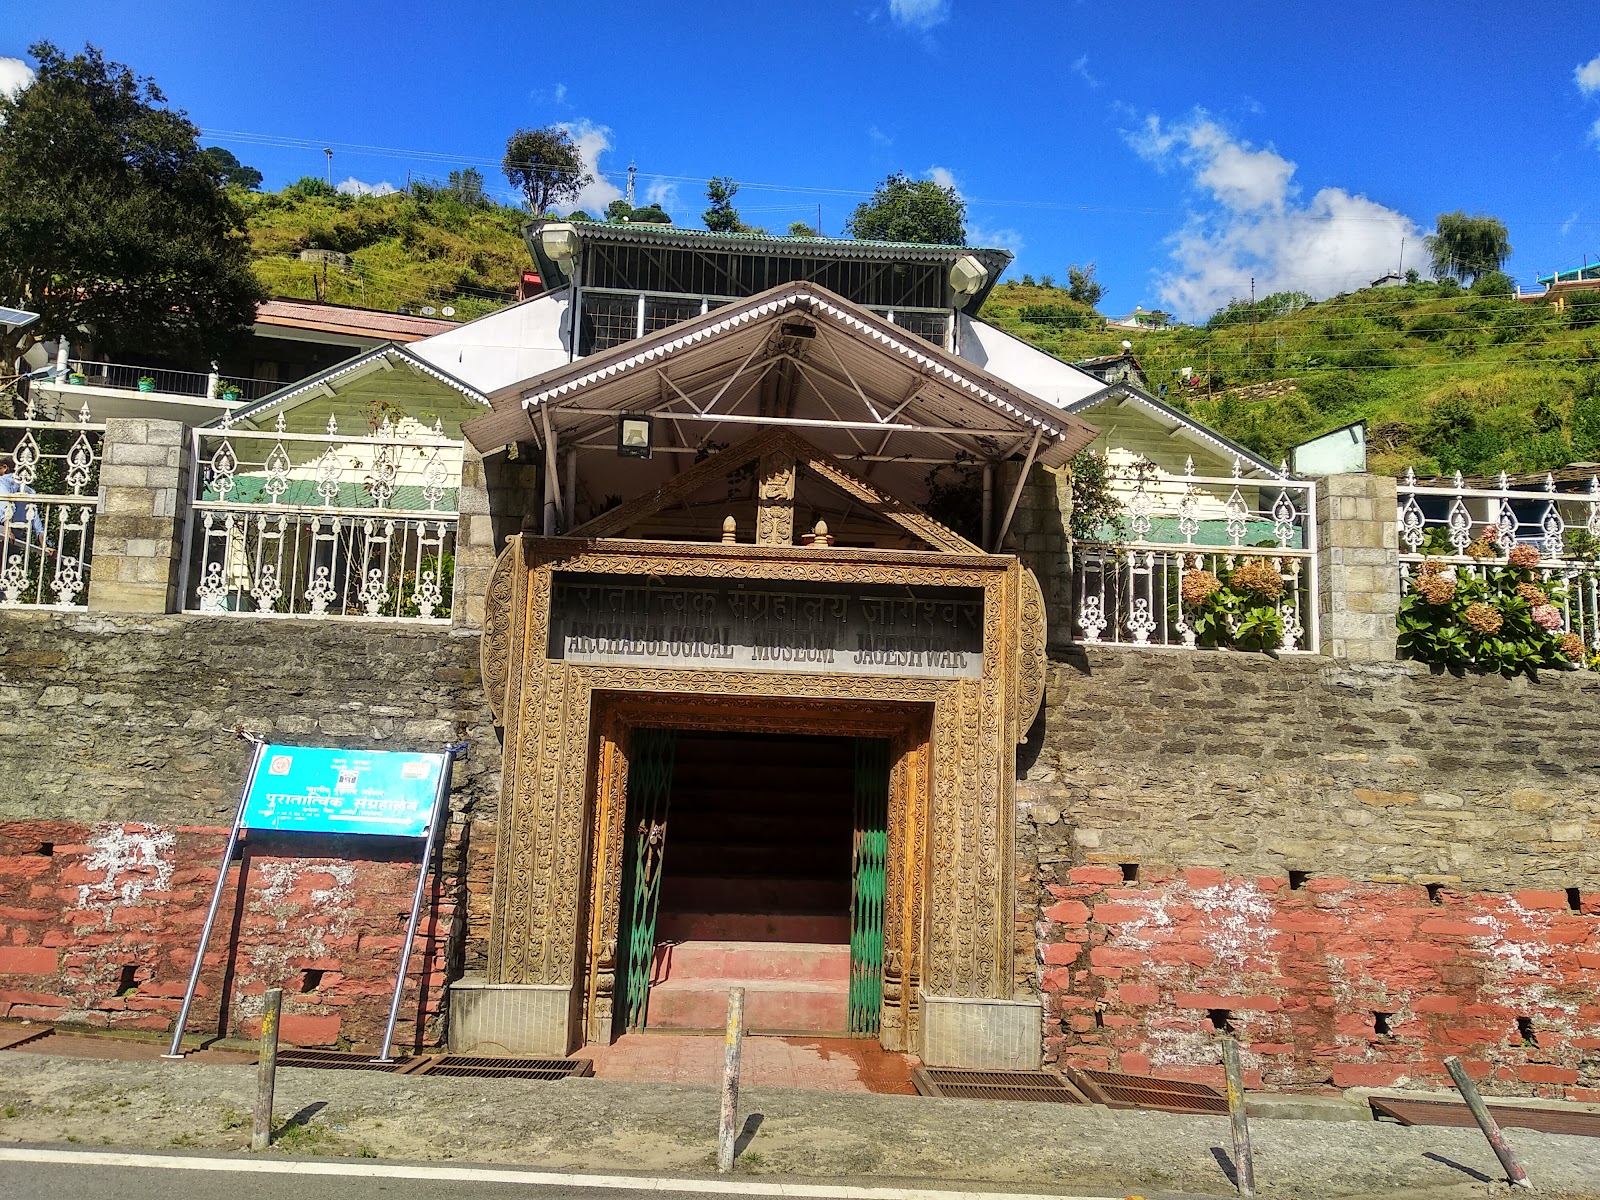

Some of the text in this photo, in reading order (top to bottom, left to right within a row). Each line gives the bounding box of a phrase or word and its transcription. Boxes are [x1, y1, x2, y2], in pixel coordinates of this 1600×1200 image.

[728, 583, 851, 622] संग्रहालय
[859, 586, 982, 629] जागेश्वर
[568, 622, 967, 668] ARCHAEOLOGICAL MUSEUM JAGESHWAR
